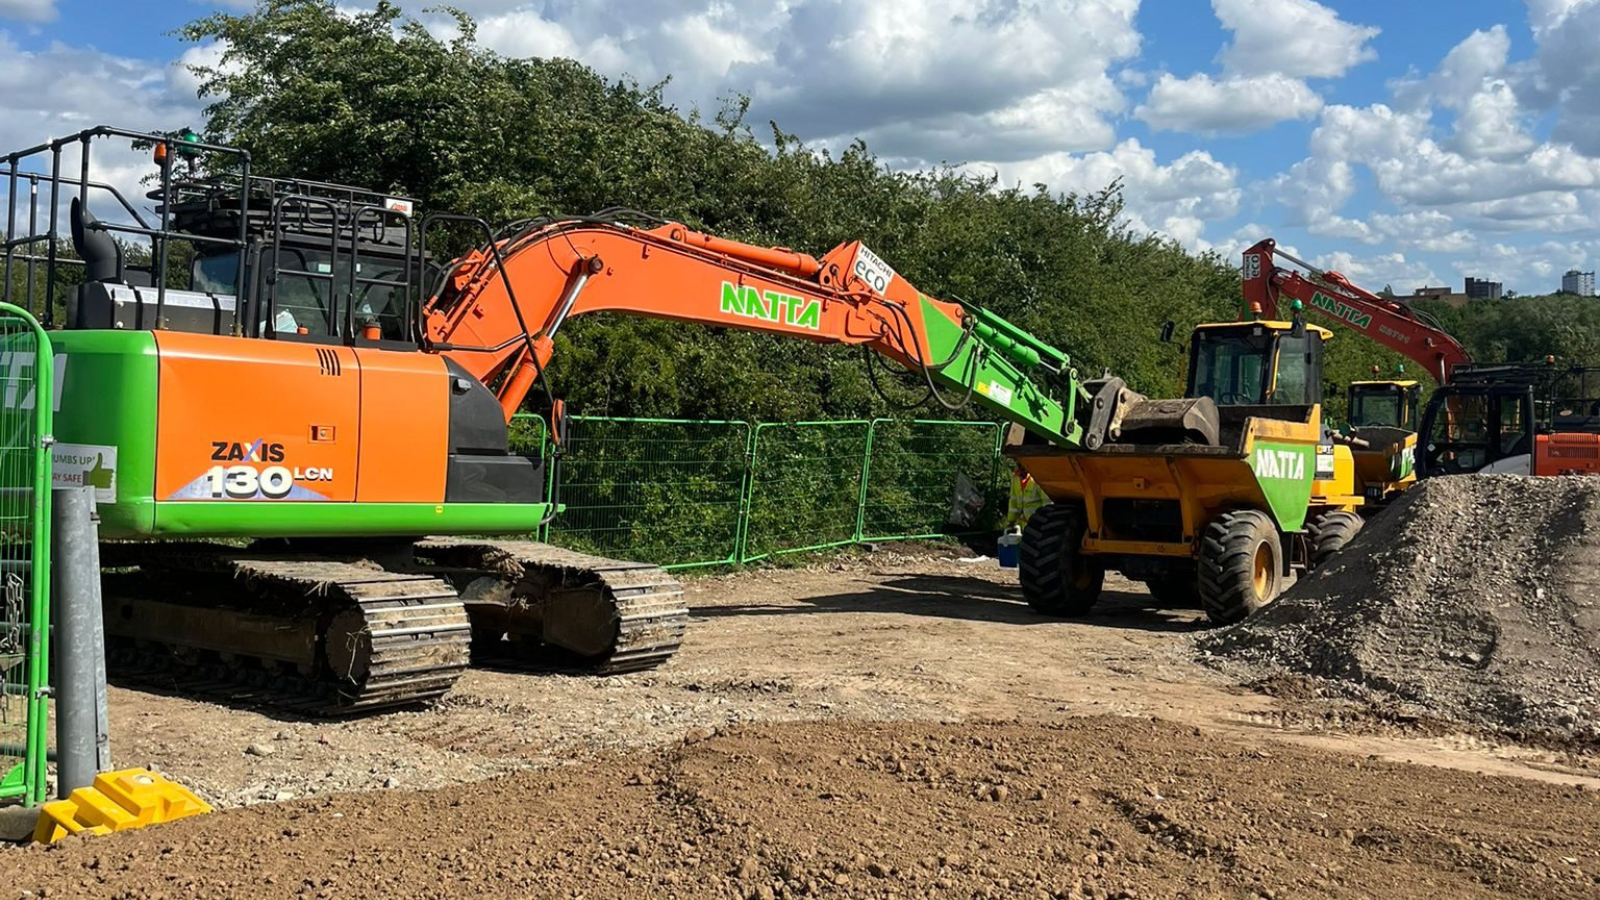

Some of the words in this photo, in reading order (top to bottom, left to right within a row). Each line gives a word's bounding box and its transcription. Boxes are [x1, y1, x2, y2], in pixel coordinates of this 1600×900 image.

[855, 260, 886, 292] eco
[860, 247, 893, 278] HITACHI
[720, 281, 821, 331] NATTA
[1310, 291, 1372, 330] NATTA
[52, 454, 77, 465] UMBS
[211, 438, 285, 462] ZAXIS
[1255, 448, 1304, 480] NATTA
[63, 473, 82, 483] SAFE
[207, 465, 293, 499] 130
[294, 467, 333, 482] LCN
